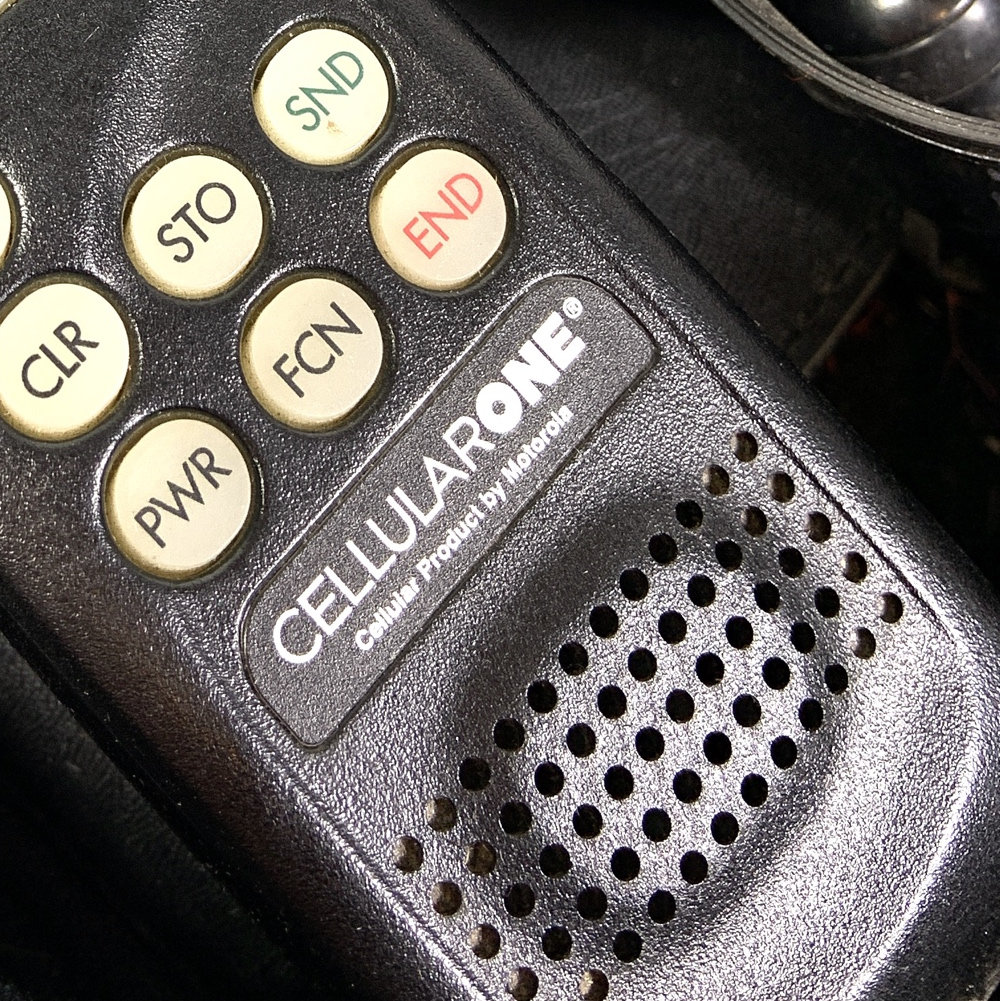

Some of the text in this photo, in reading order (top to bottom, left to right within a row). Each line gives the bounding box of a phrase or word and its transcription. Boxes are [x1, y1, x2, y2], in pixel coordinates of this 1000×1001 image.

[285, 50, 364, 132] SND
[156, 181, 237, 263] STO
[402, 172, 484, 260] END
[21, 320, 100, 399] CLR
[272, 301, 364, 398] FCN
[134, 446, 233, 546] PWR
[354, 405, 574, 651] Cellular Product by Motorola
